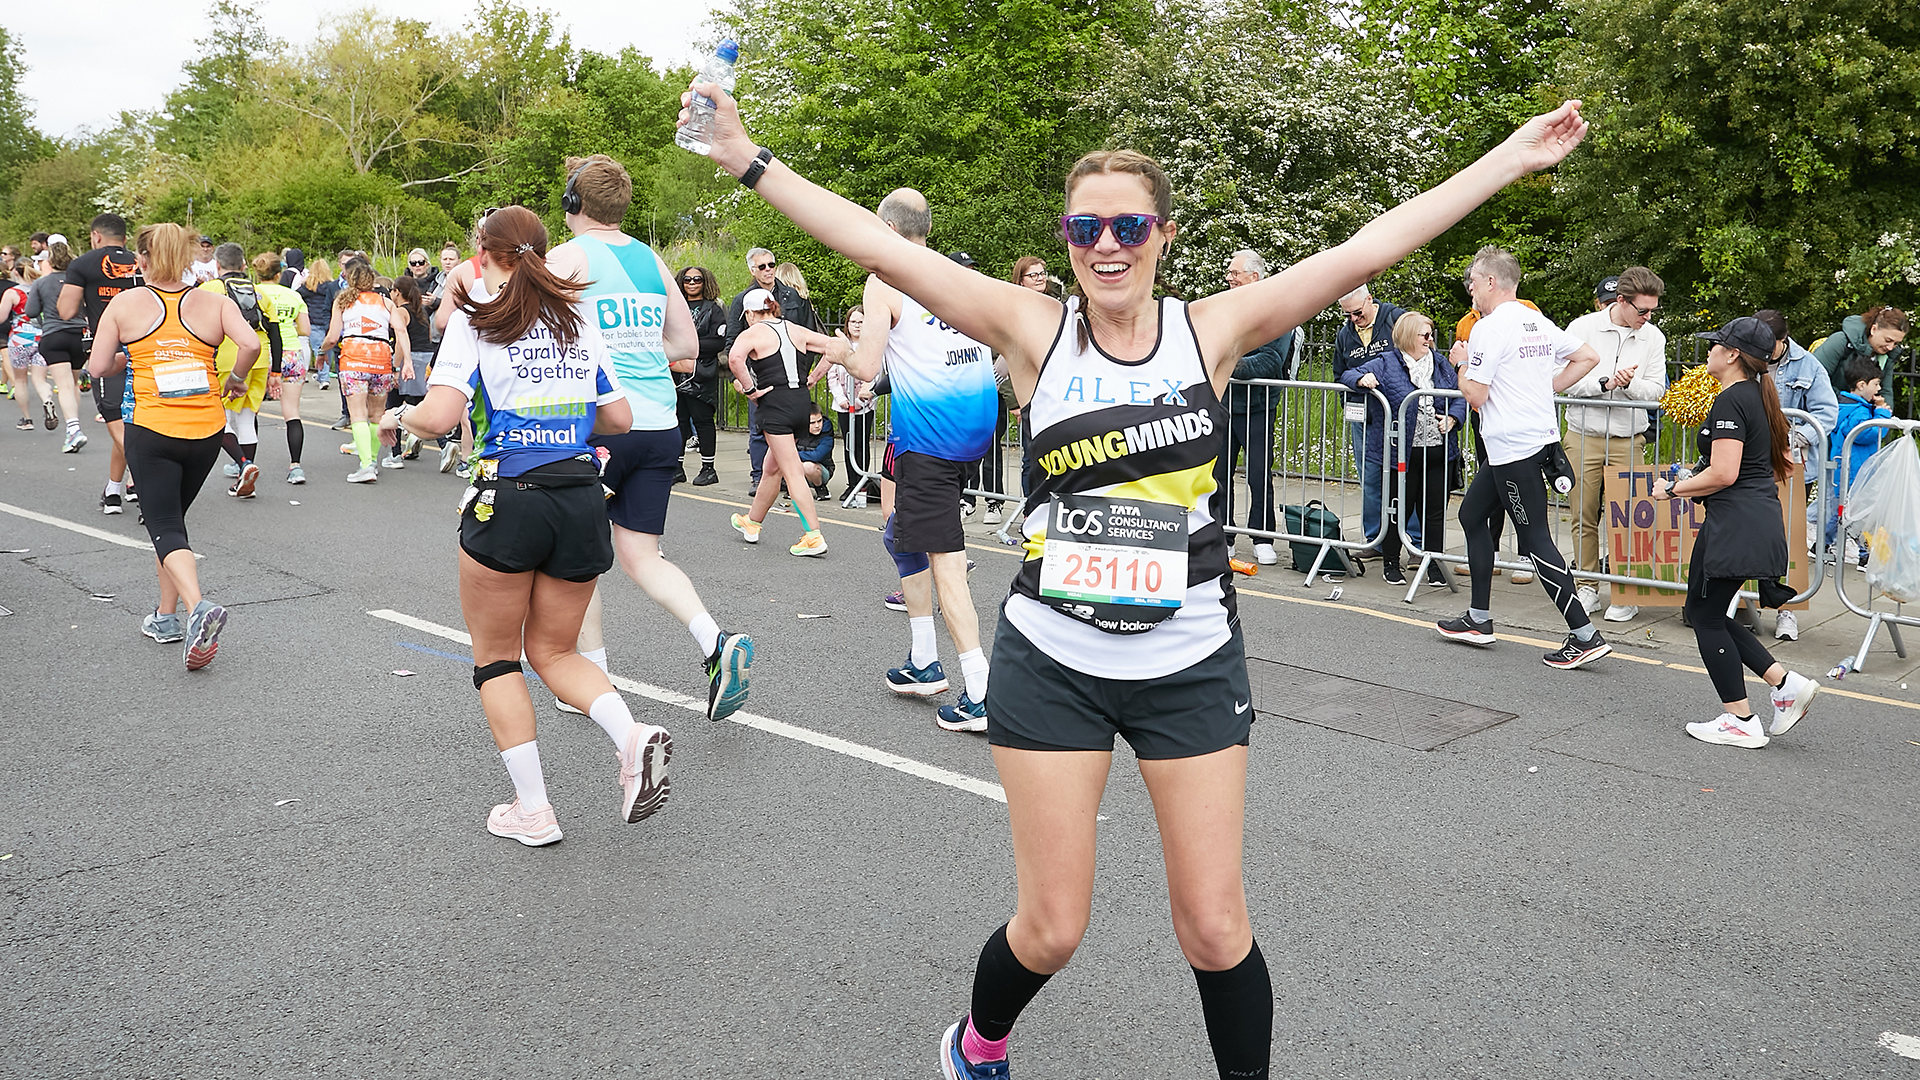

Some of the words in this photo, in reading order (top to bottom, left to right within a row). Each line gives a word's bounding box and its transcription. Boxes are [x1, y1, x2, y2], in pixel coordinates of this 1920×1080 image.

[596, 297, 662, 330] Bliss
[601, 331, 614, 340] for
[617, 329, 643, 339] babies
[507, 342, 590, 363] Paralysis
[436, 360, 463, 369] spinal
[511, 362, 590, 383] Together
[1063, 376, 1187, 406] ALEX
[515, 396, 587, 417] CHELSEA
[508, 424, 577, 447] spinal
[1038, 408, 1214, 480] YOUNGMINDS
[1056, 501, 1103, 536] tcs
[1109, 505, 1141, 516] TATA
[1108, 516, 1180, 532] CONSULTANCY
[1610, 500, 1655, 528] NO
[1107, 527, 1154, 541] SERVICES
[1614, 531, 1683, 563] LIKE
[1062, 554, 1163, 593] 25110
[1095, 618, 1119, 630] new
